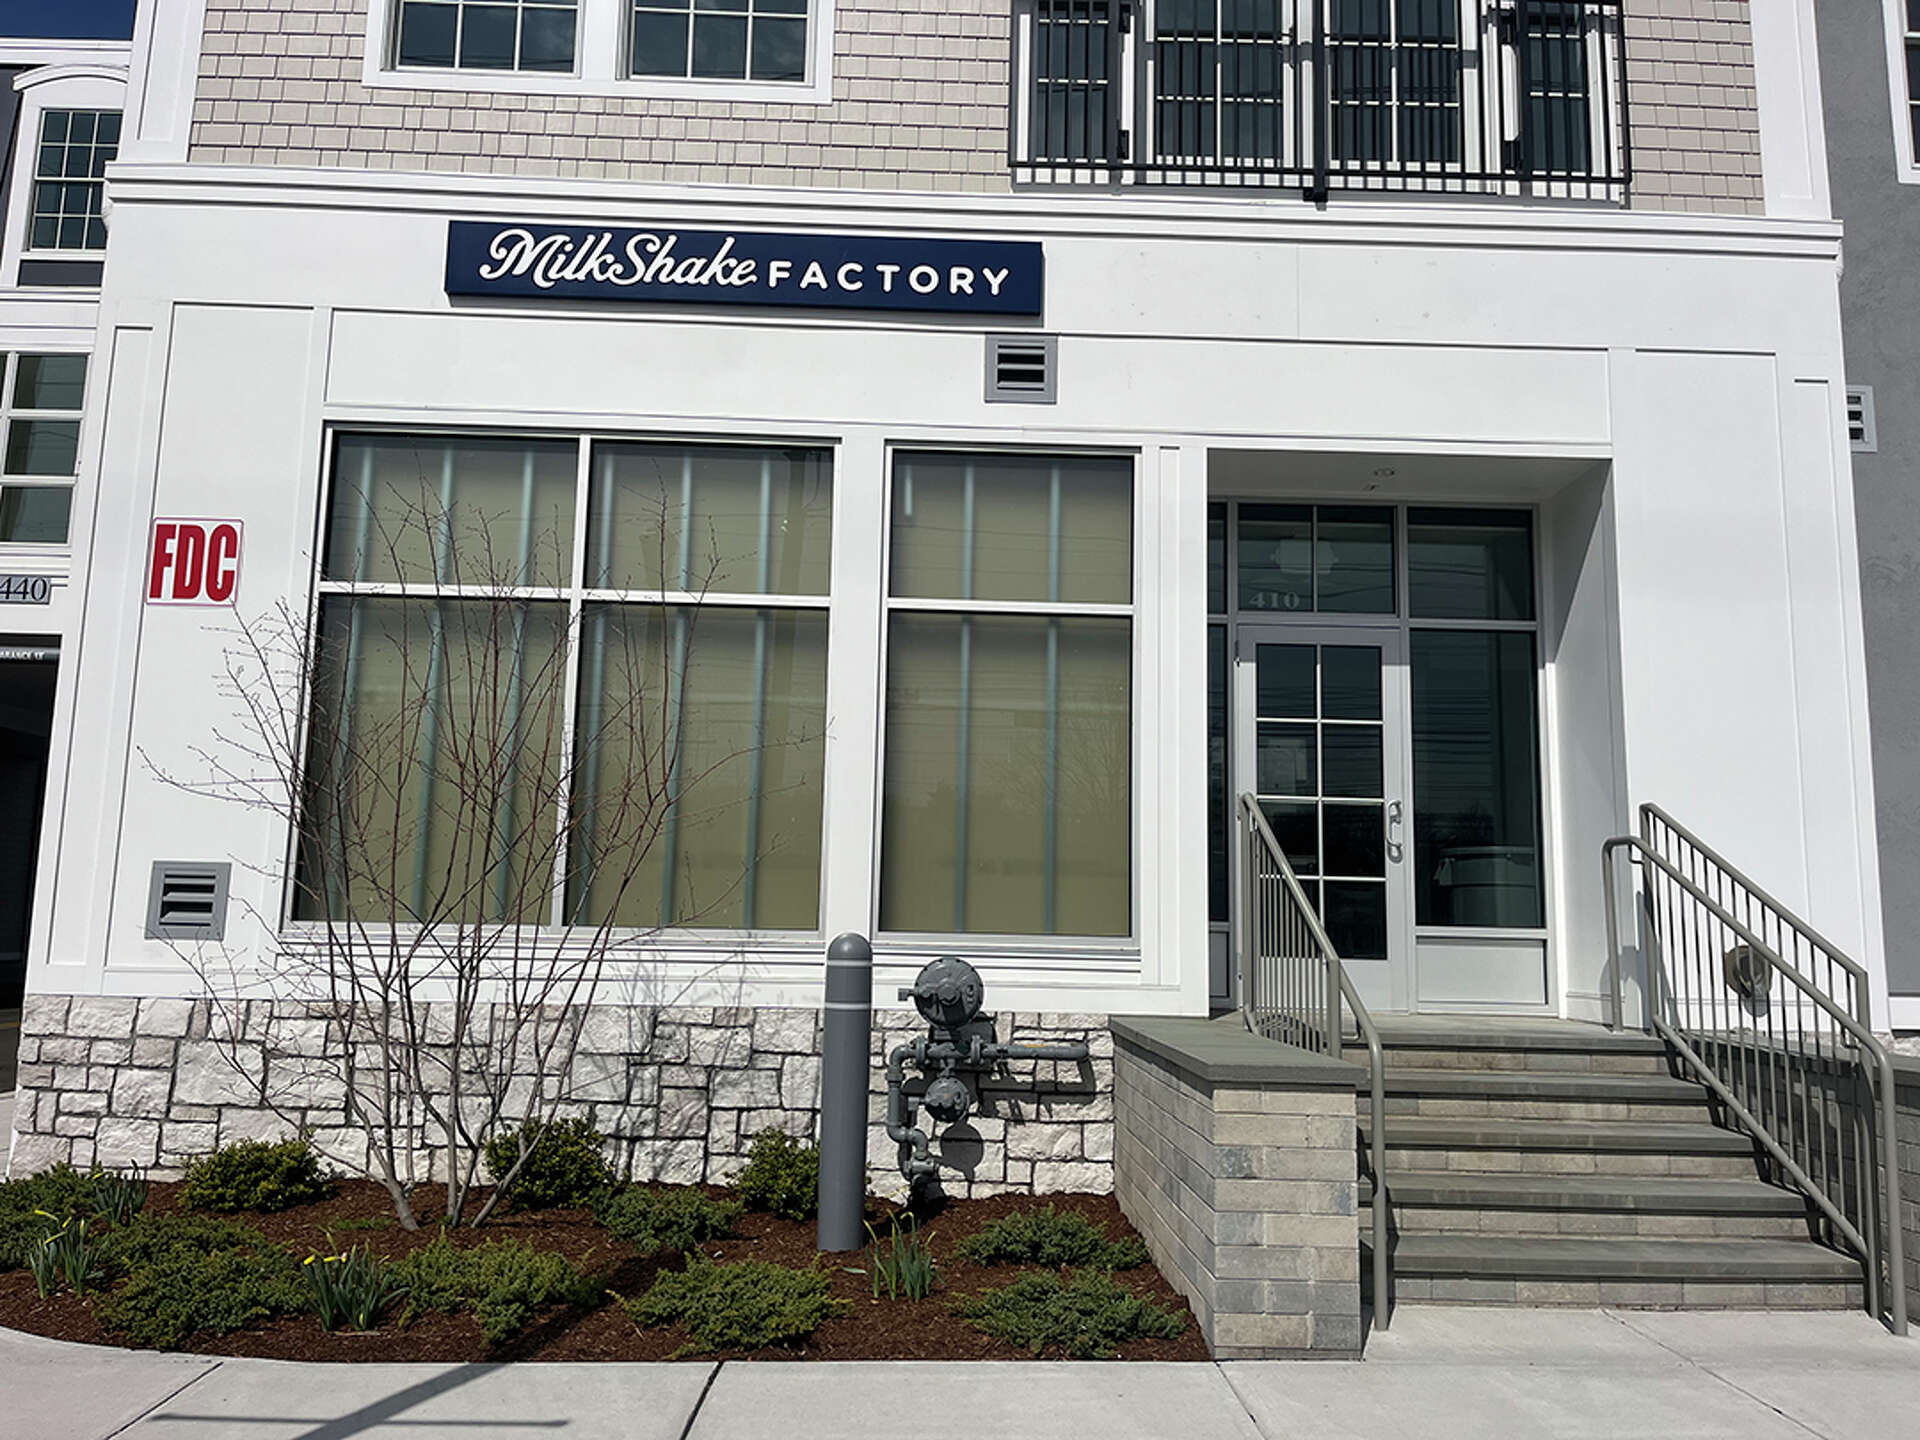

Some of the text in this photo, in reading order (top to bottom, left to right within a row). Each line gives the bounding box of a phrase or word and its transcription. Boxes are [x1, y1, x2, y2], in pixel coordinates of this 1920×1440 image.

[479, 228, 1009, 297] MilkShake FACTORY
[150, 523, 238, 602] FDC
[0, 576, 48, 601] 440
[1248, 591, 1300, 610] 410
